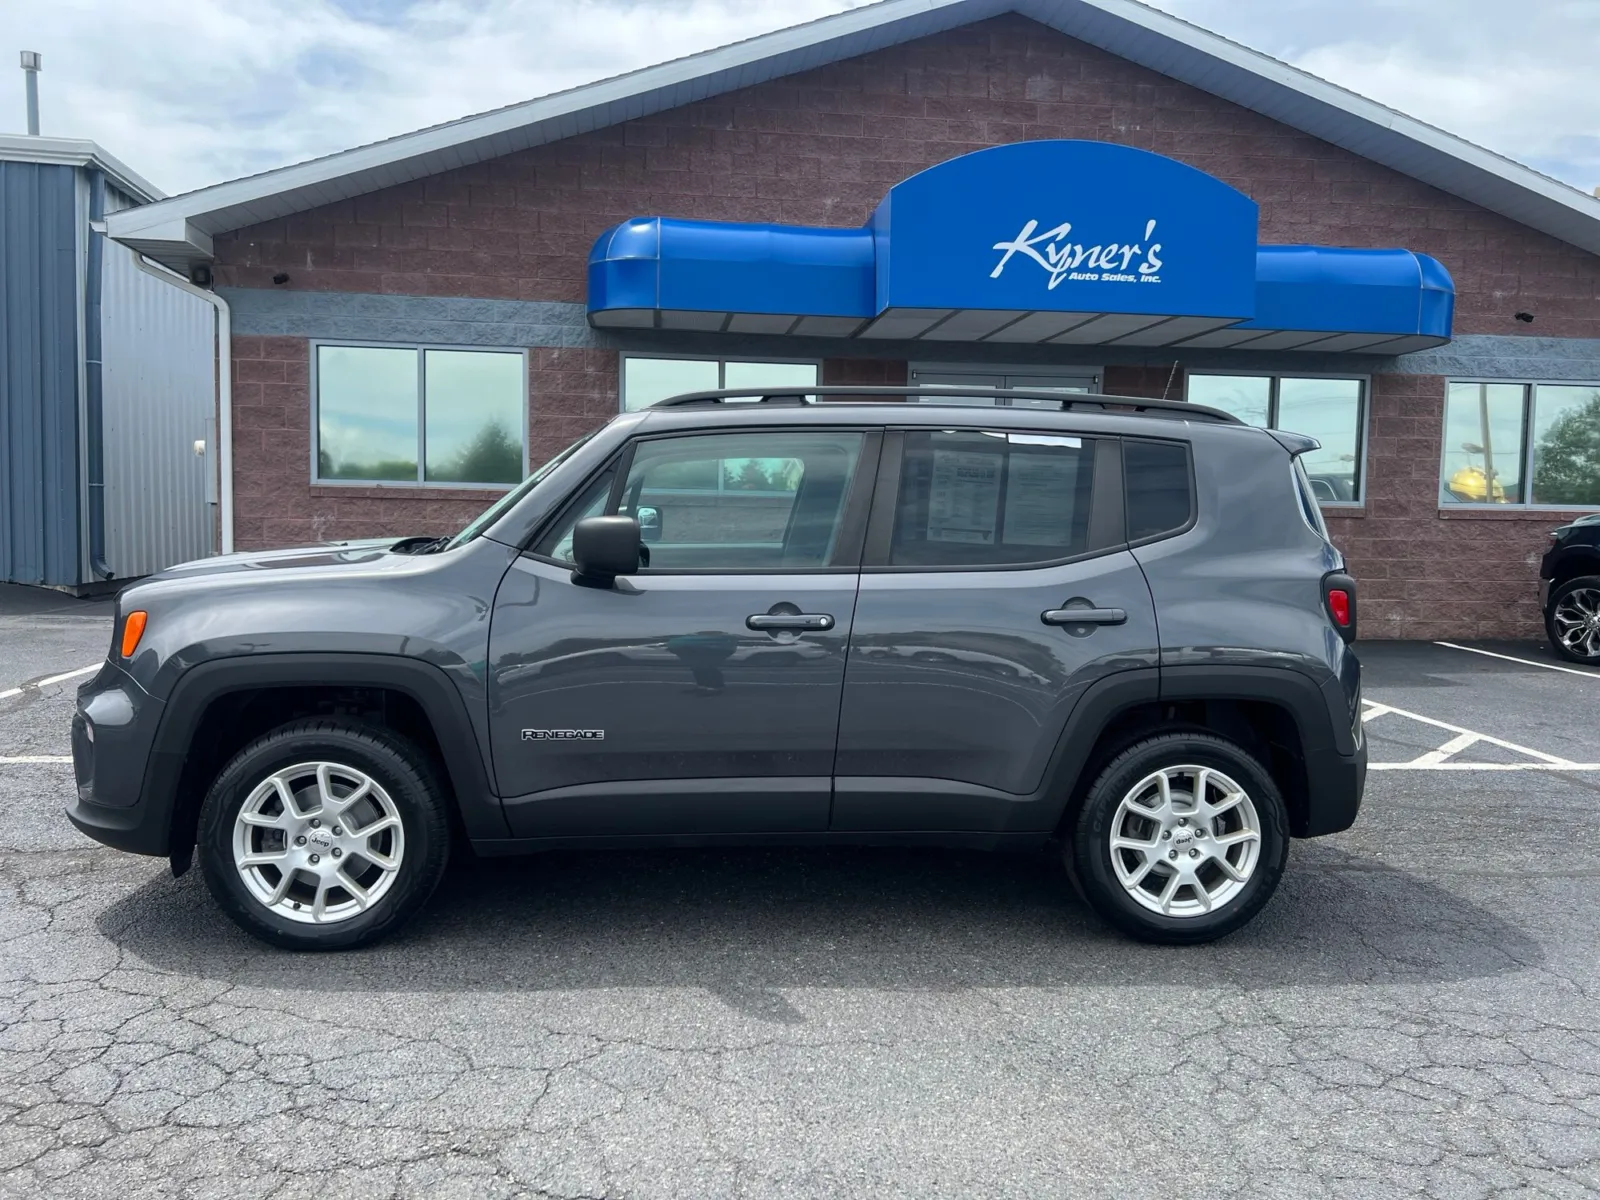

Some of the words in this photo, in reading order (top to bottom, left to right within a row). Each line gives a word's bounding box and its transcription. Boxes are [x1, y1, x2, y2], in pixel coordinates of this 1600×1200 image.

[990, 219, 1163, 291] Kyner's
[1068, 272, 1099, 281] Auto
[1101, 273, 1137, 283] Sales,
[1140, 274, 1161, 283] Inc.
[521, 729, 605, 741] RENEGADE
[311, 837, 330, 848] Jeep
[1175, 837, 1193, 845] Jeep
